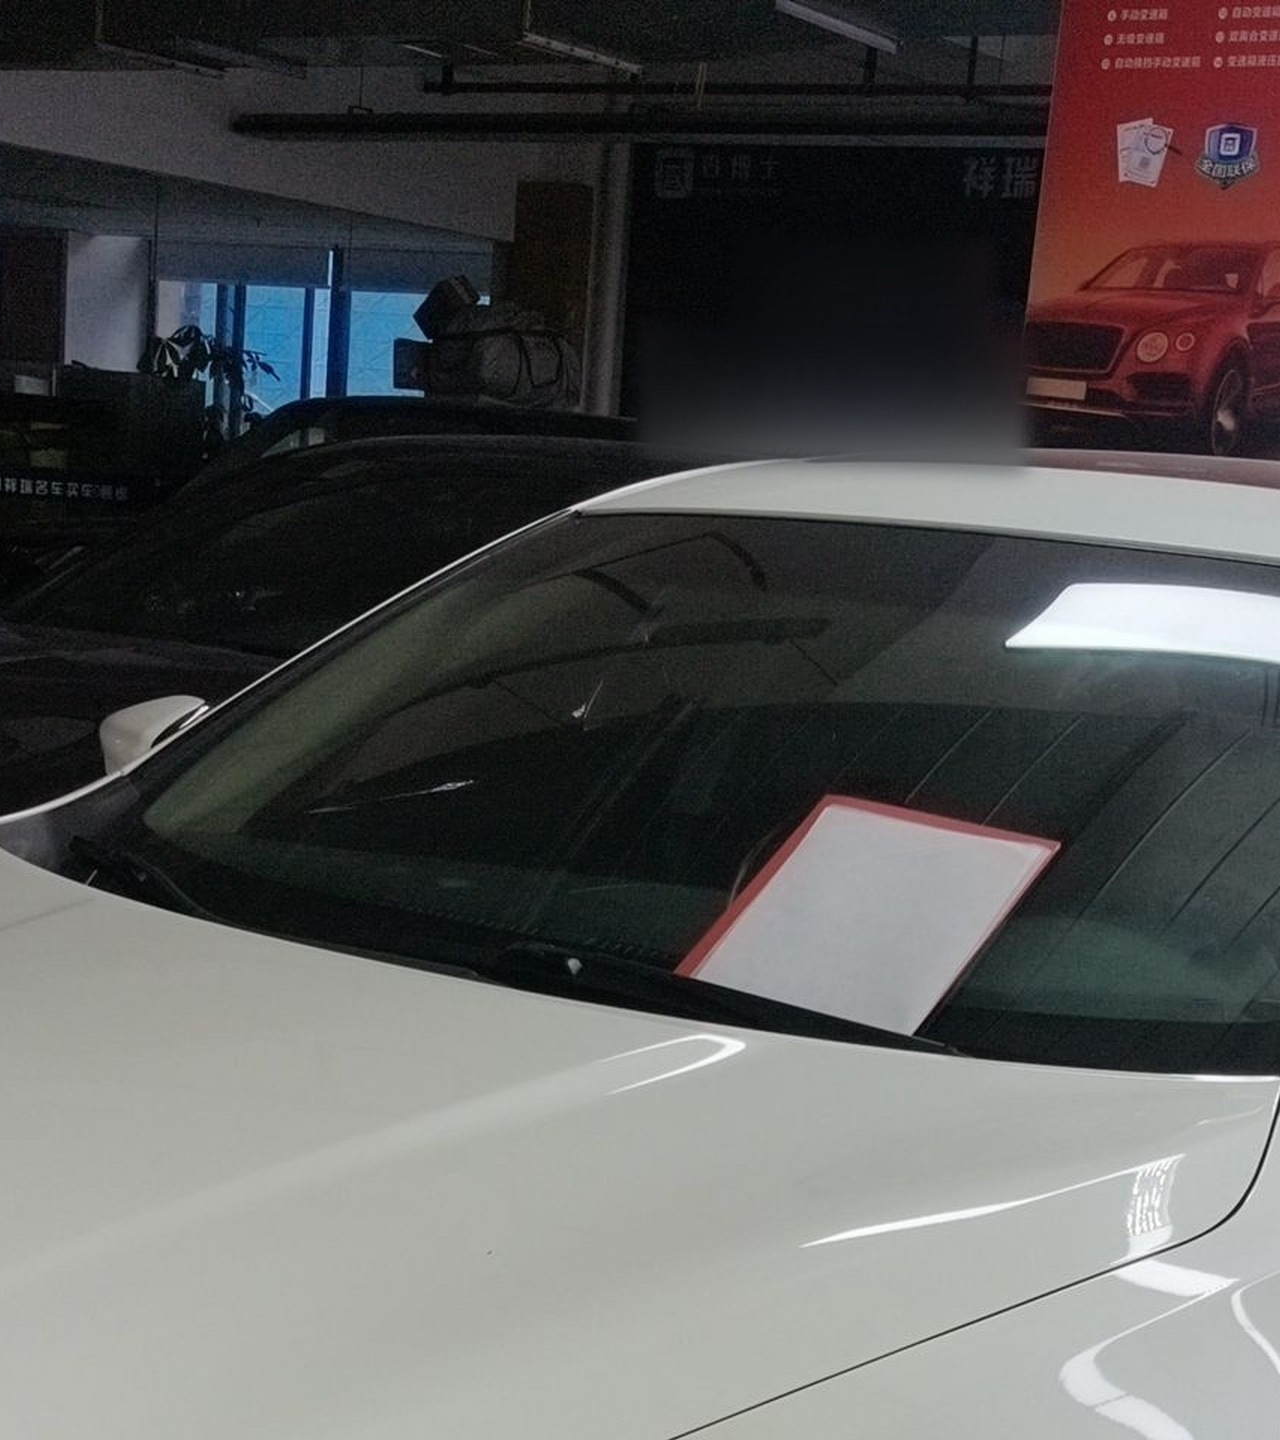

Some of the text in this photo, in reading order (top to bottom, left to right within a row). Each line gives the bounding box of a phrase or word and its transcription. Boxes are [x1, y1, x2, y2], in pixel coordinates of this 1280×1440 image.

[1120, 8, 1169, 21] 手动变速箱
[1116, 32, 1165, 45] 无级变速箱
